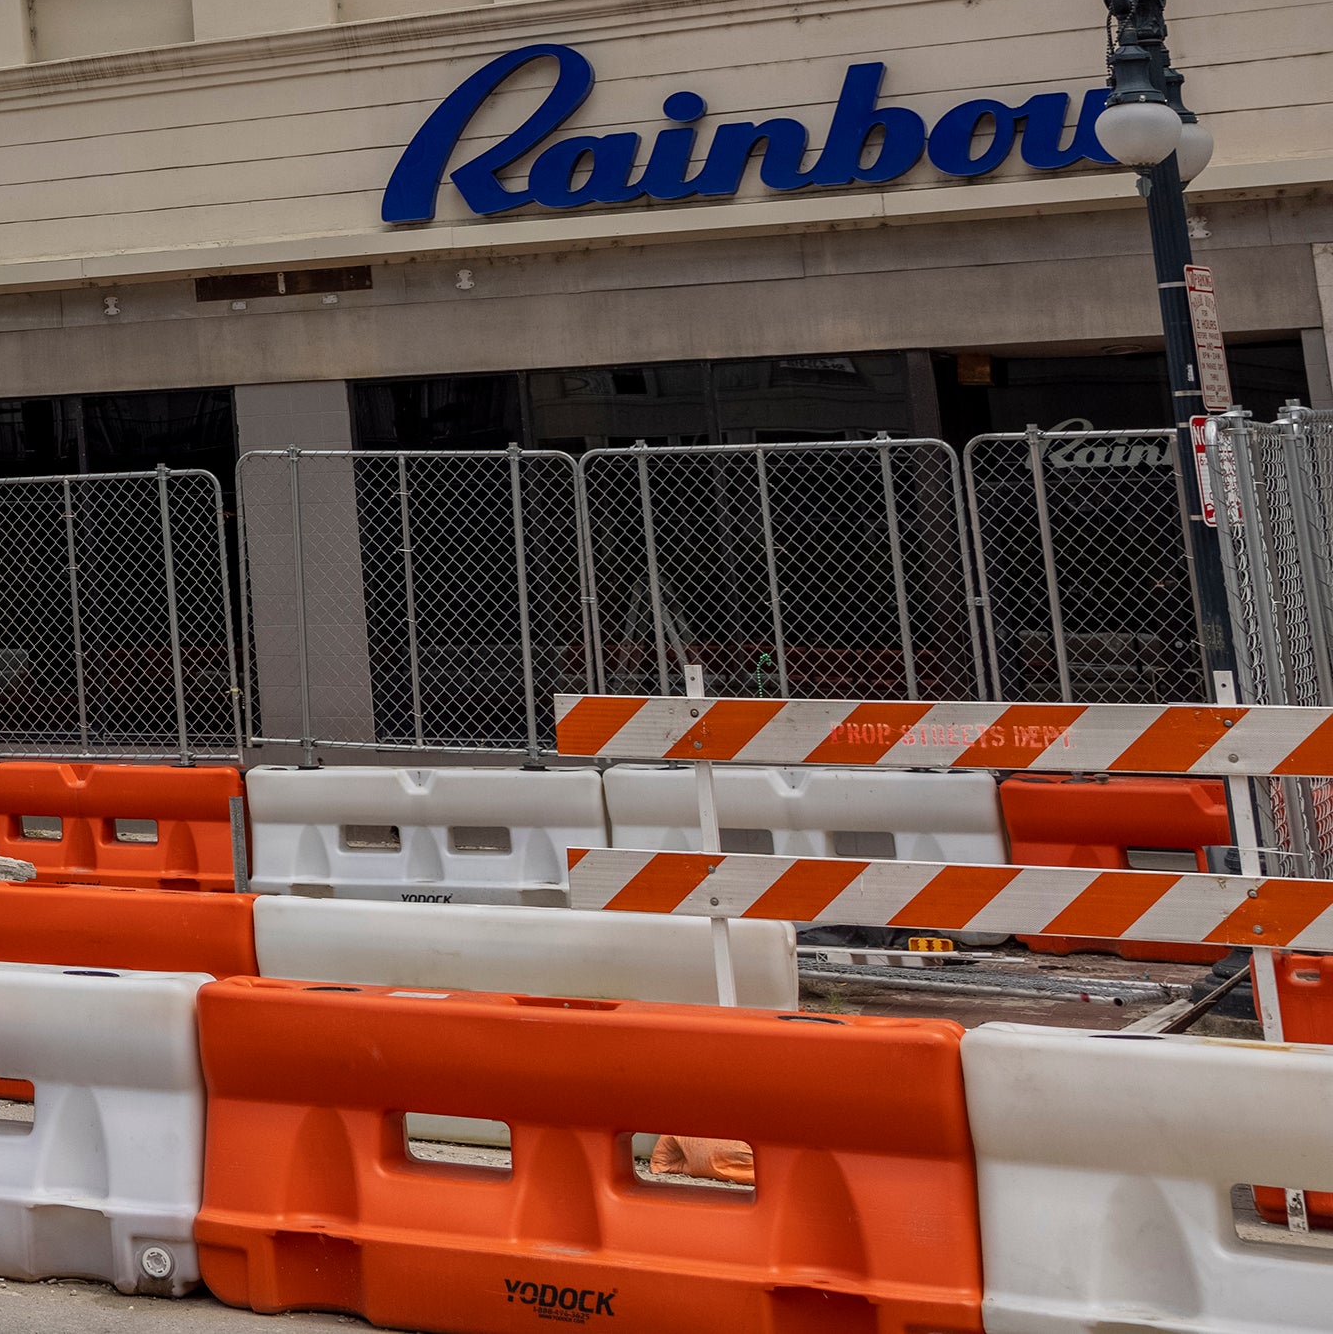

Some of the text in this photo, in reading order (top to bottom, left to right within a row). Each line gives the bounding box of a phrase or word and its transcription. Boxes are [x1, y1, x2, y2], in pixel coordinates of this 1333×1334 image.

[1201, 319, 1218, 331] HOURS
[901, 723, 1006, 748] STREETS
[504, 1278, 616, 1316] YODOCK
